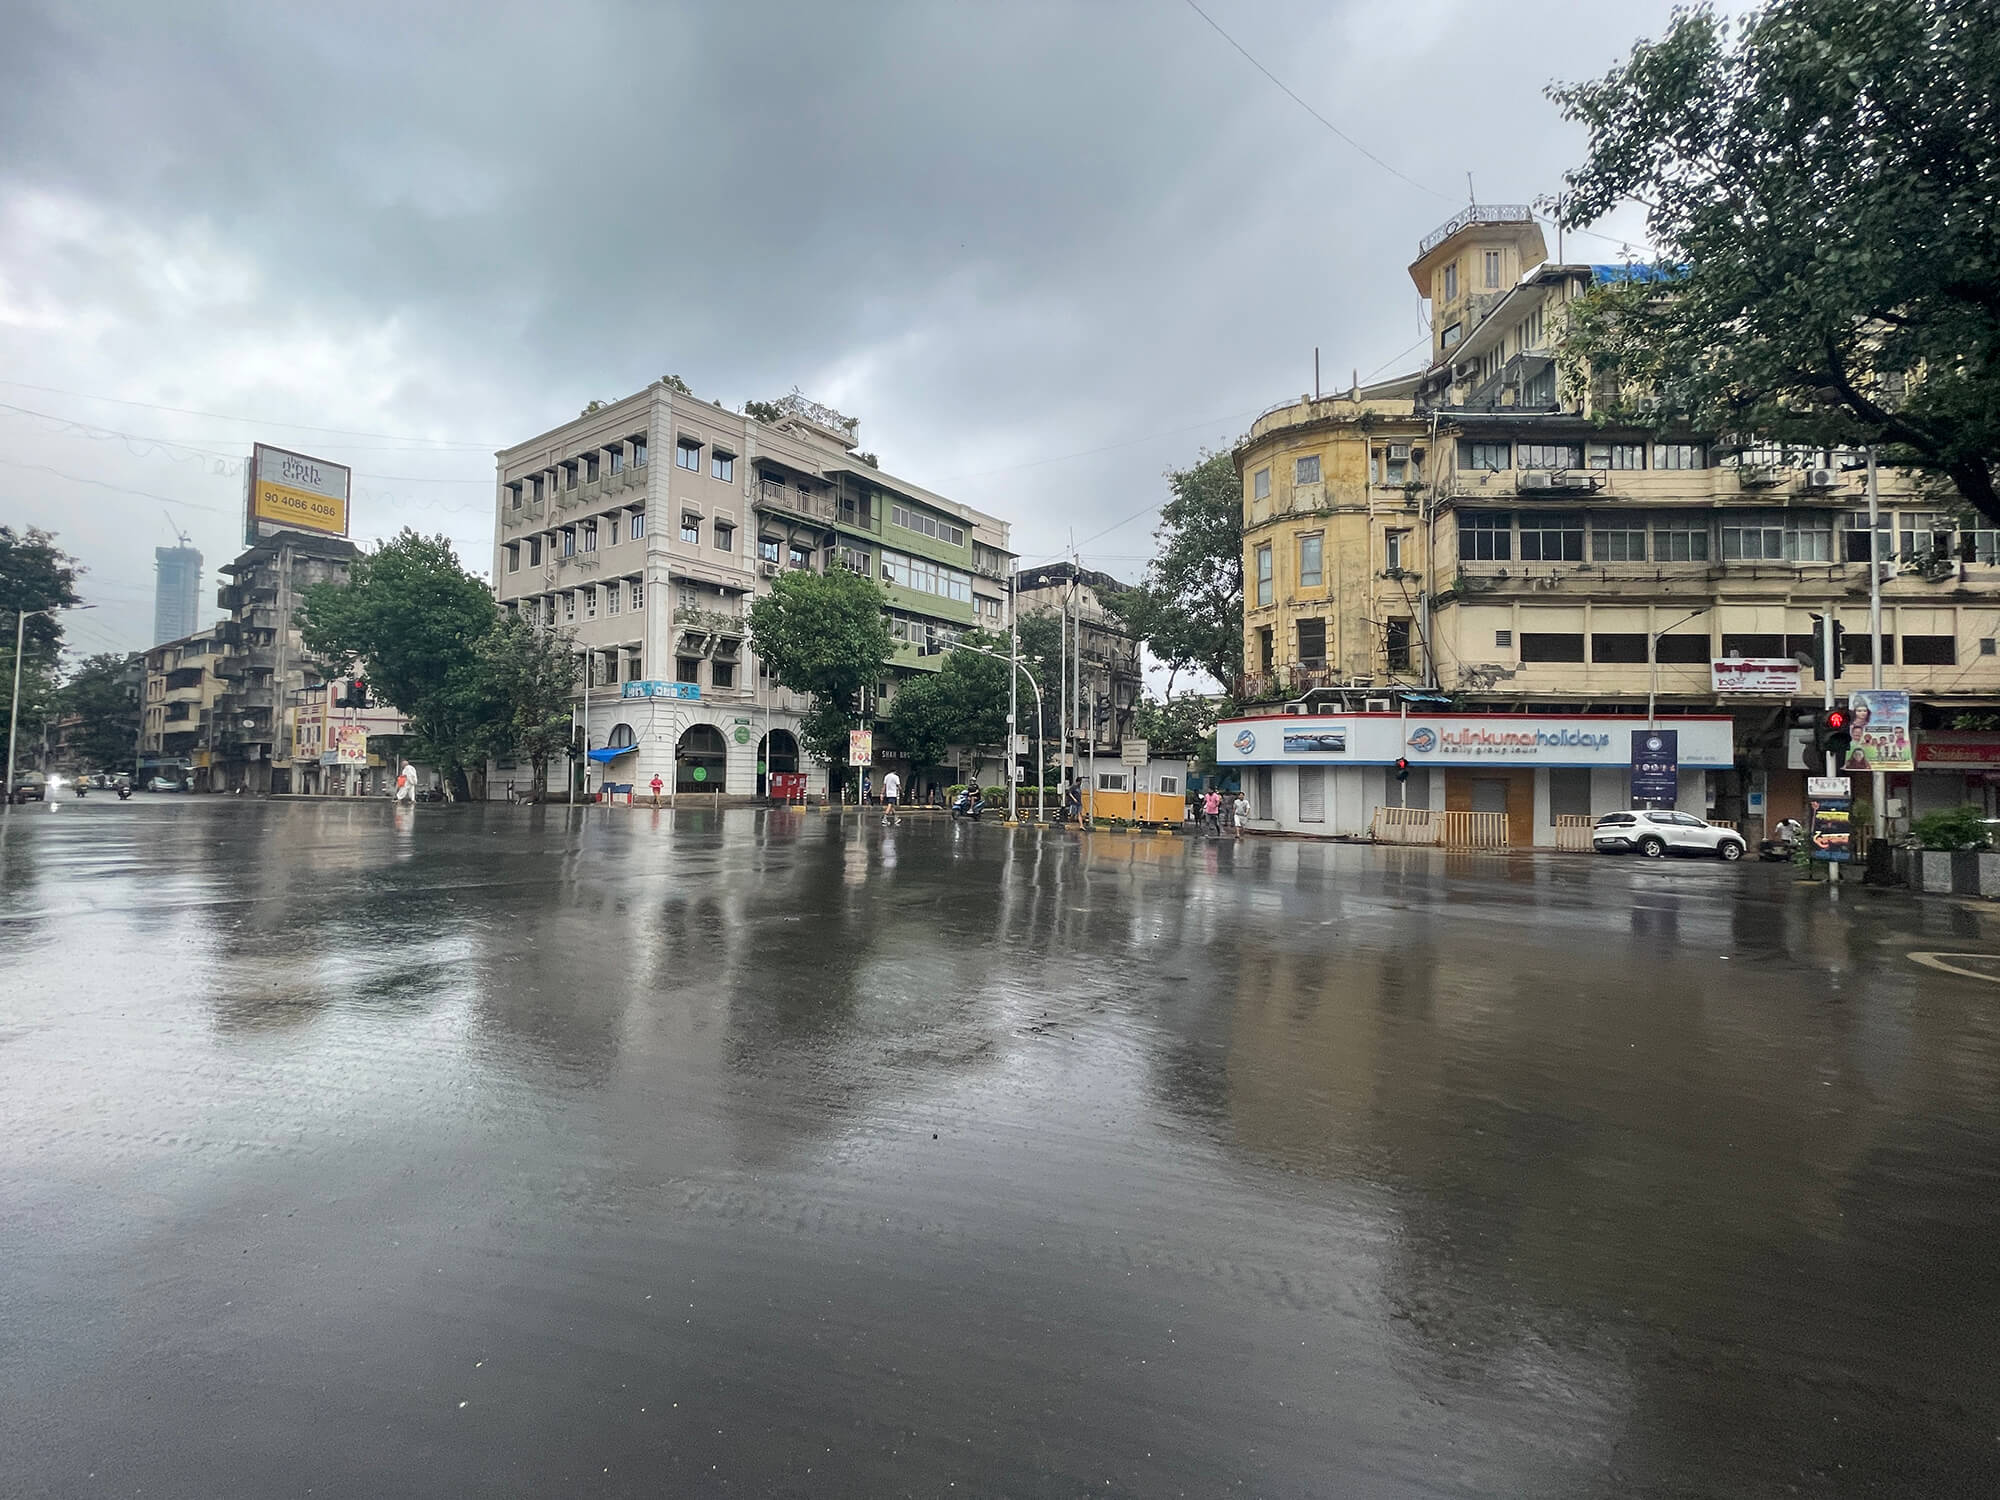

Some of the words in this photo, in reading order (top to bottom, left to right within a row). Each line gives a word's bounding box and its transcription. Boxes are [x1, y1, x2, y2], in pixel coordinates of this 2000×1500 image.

[264, 492, 279, 504] 90
[281, 496, 308, 510] 4086
[310, 503, 336, 517] 4086
